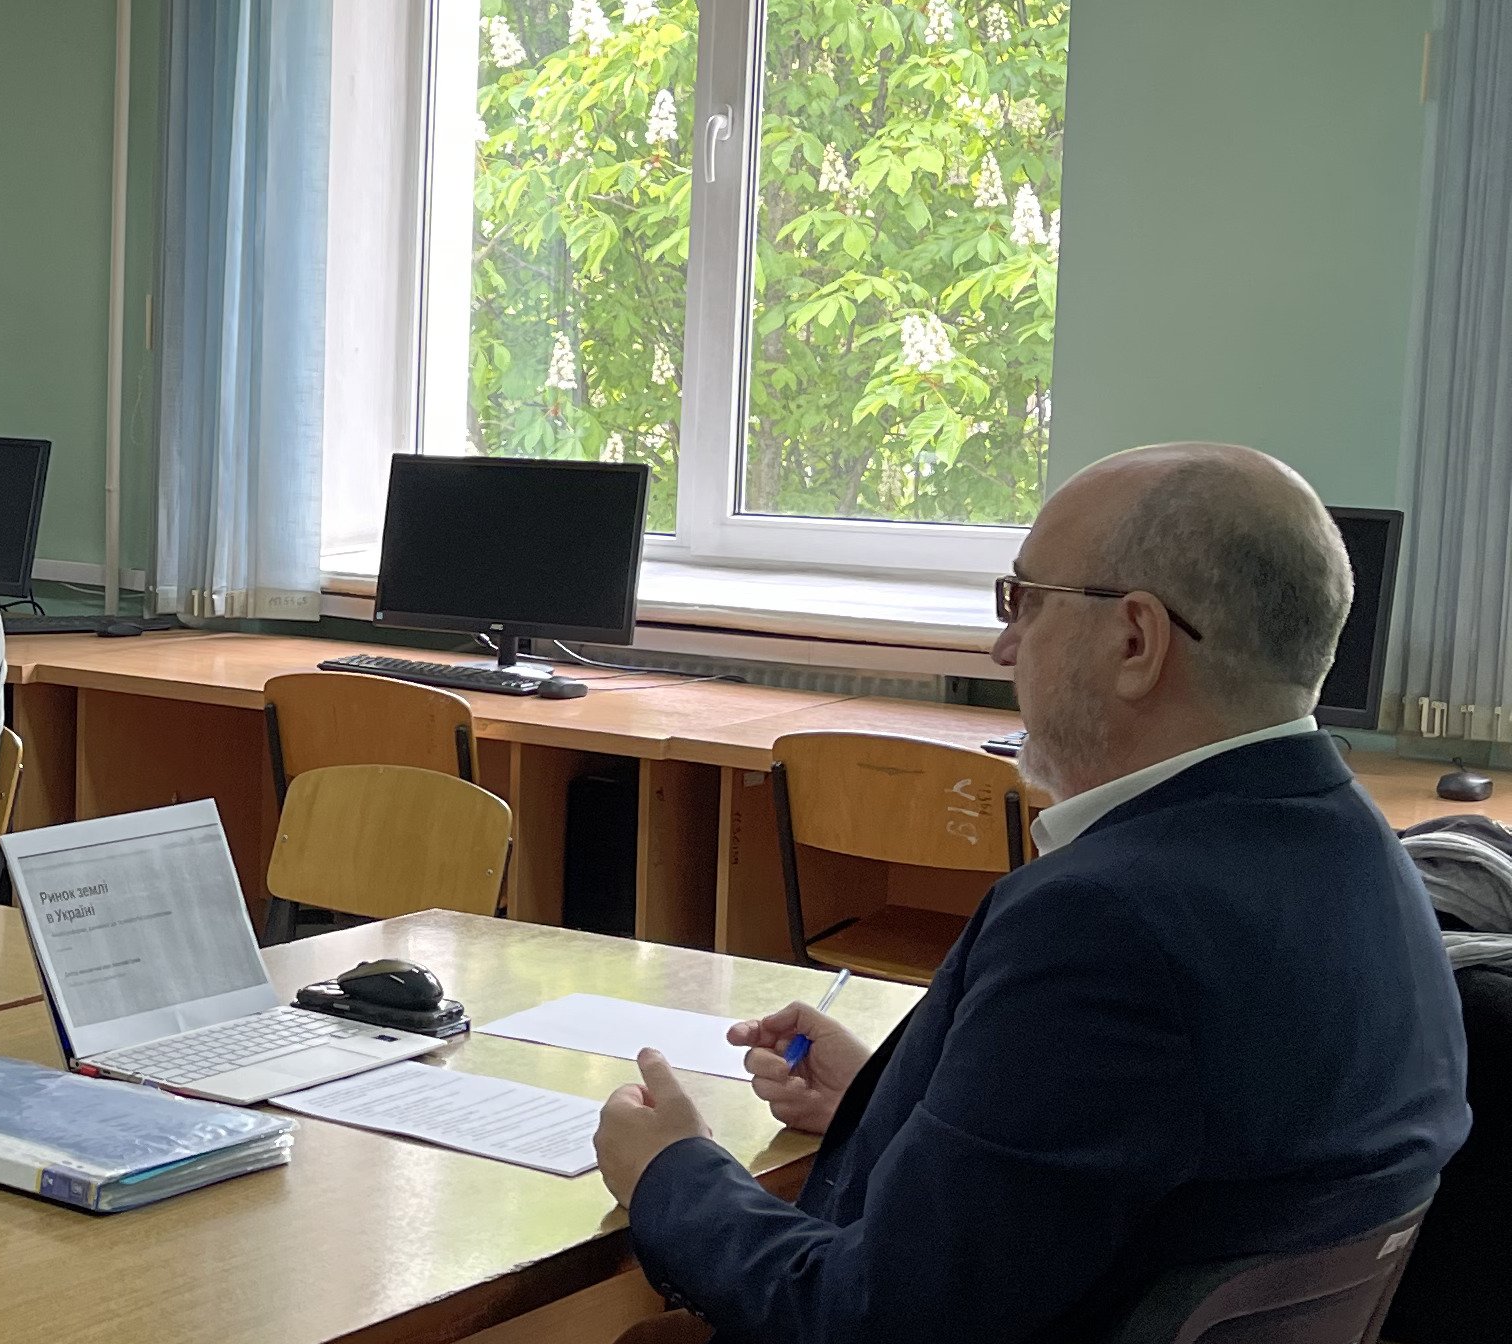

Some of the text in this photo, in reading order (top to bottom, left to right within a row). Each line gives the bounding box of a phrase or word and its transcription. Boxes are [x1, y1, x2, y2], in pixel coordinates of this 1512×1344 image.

[39, 881, 108, 905] Ринок землі
[46, 913, 55, 924] в
[55, 903, 96, 923] Україні
